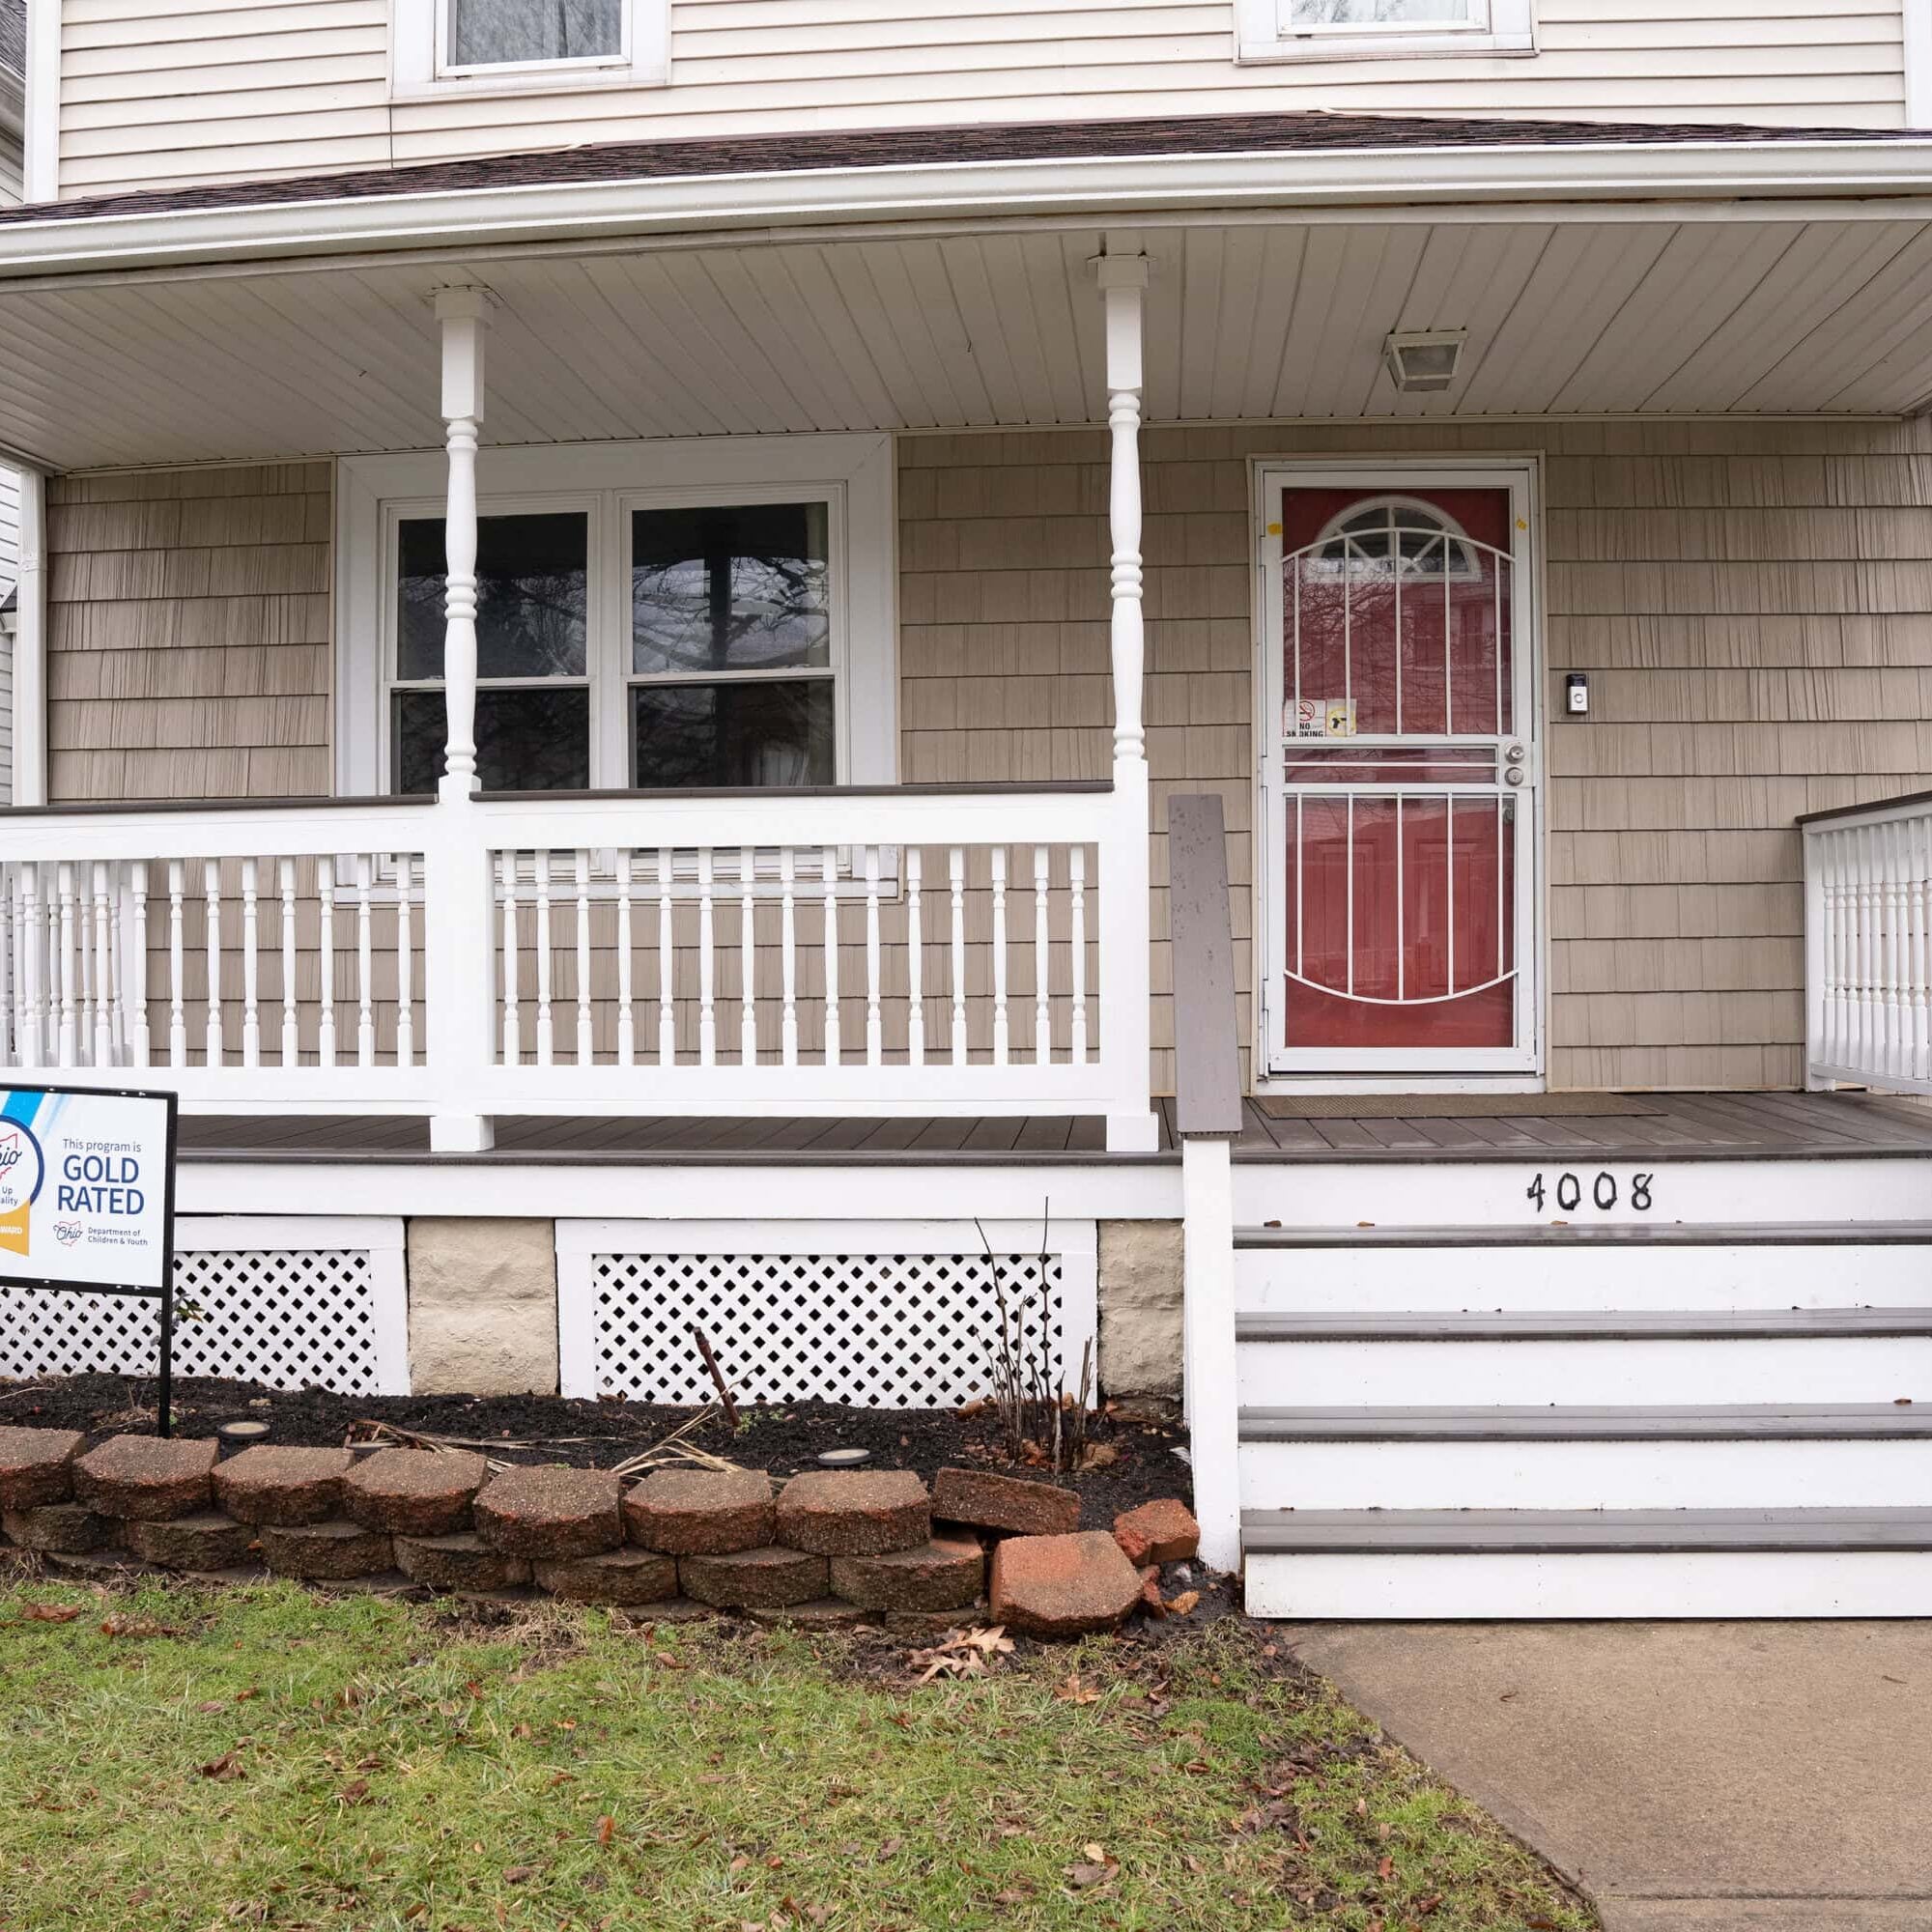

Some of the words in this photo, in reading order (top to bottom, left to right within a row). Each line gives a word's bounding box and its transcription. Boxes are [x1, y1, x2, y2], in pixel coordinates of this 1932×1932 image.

[63, 1138, 84, 1150] This
[86, 1142, 130, 1153] program
[133, 1141, 142, 1151] is
[64, 1154, 139, 1183] GOLD
[2, 1186, 13, 1195] Up
[1527, 1171, 1653, 1212] 4008
[0, 1197, 18, 1206] ality
[58, 1184, 145, 1215] RATED
[0, 1225, 22, 1234] WARD
[53, 1224, 83, 1240] Ohio
[88, 1228, 131, 1237] Department
